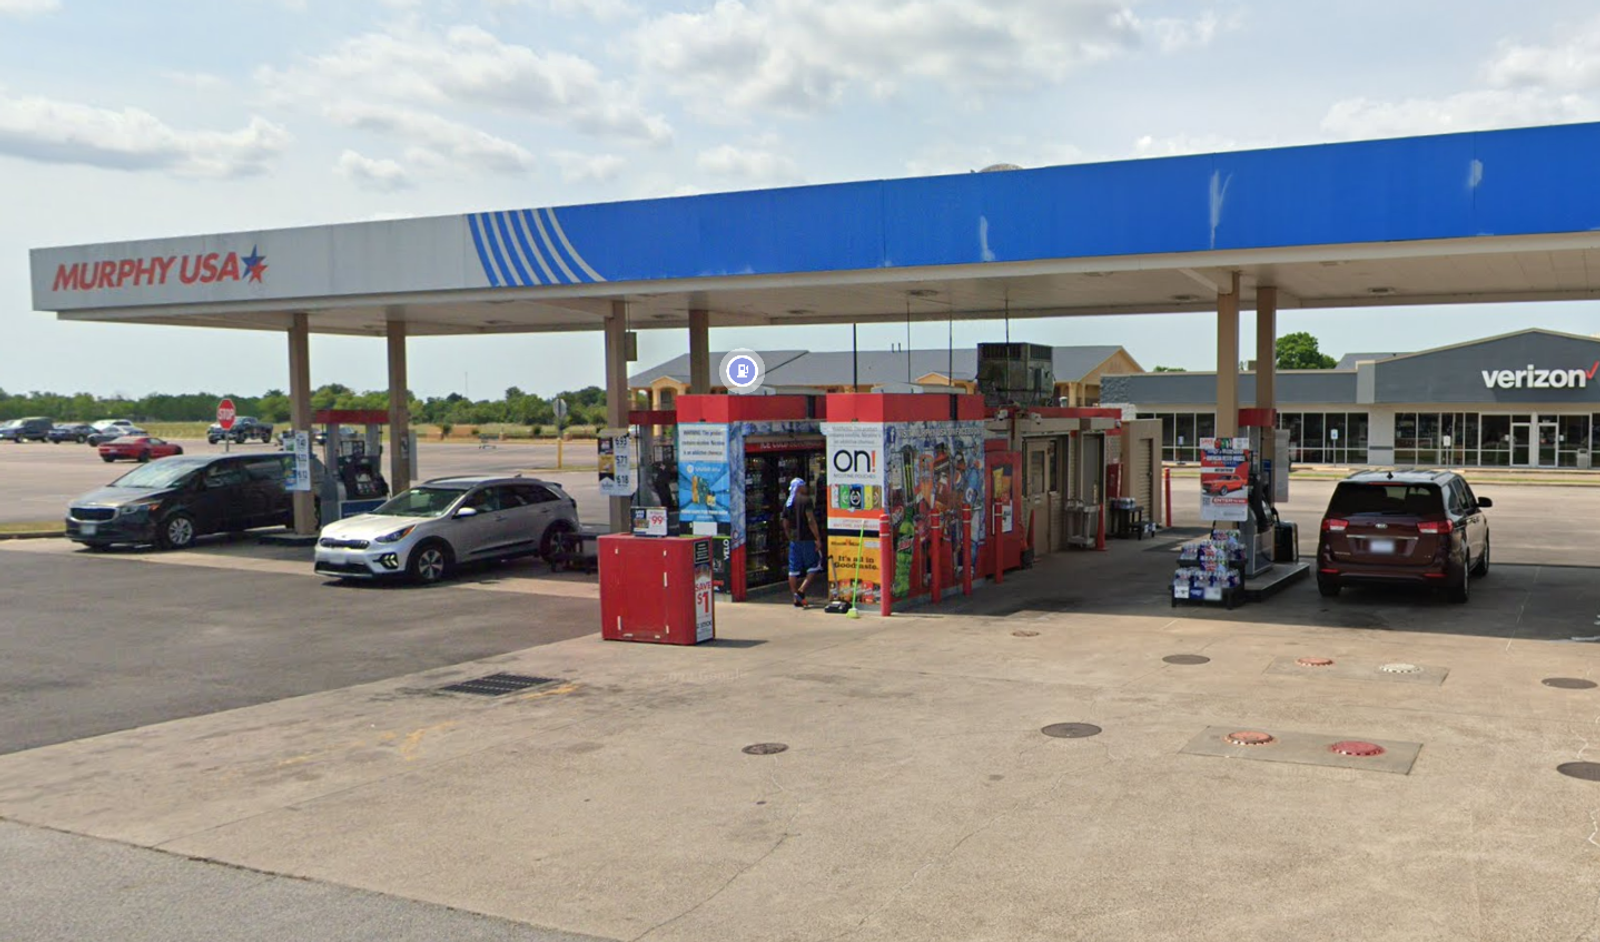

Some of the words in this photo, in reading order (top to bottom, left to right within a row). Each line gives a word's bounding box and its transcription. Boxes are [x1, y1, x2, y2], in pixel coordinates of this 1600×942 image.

[52, 255, 177, 292] MURPHY
[179, 252, 240, 285] USA
[1481, 364, 1586, 388] verizon
[218, 408, 235, 420] STOP
[833, 449, 876, 473] on!
[695, 581, 711, 592] SAVE
[697, 591, 709, 614] $1
